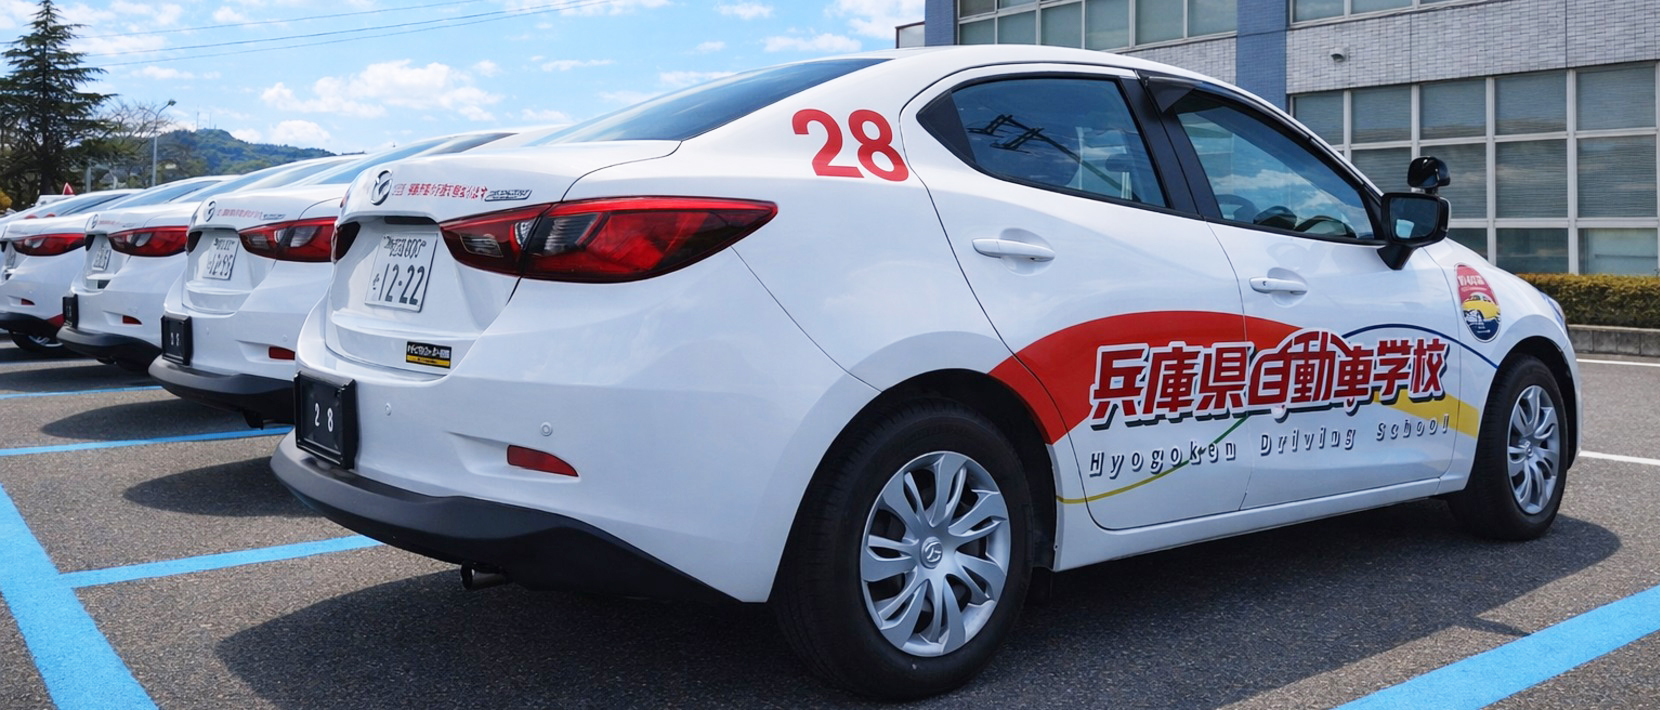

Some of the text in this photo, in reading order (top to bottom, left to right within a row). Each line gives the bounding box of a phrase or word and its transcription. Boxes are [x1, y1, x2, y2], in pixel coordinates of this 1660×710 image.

[791, 108, 910, 182] 28
[1090, 328, 1450, 430] 兵庫県自動車学校
[1089, 413, 1451, 480] Hyogoken Driving School
